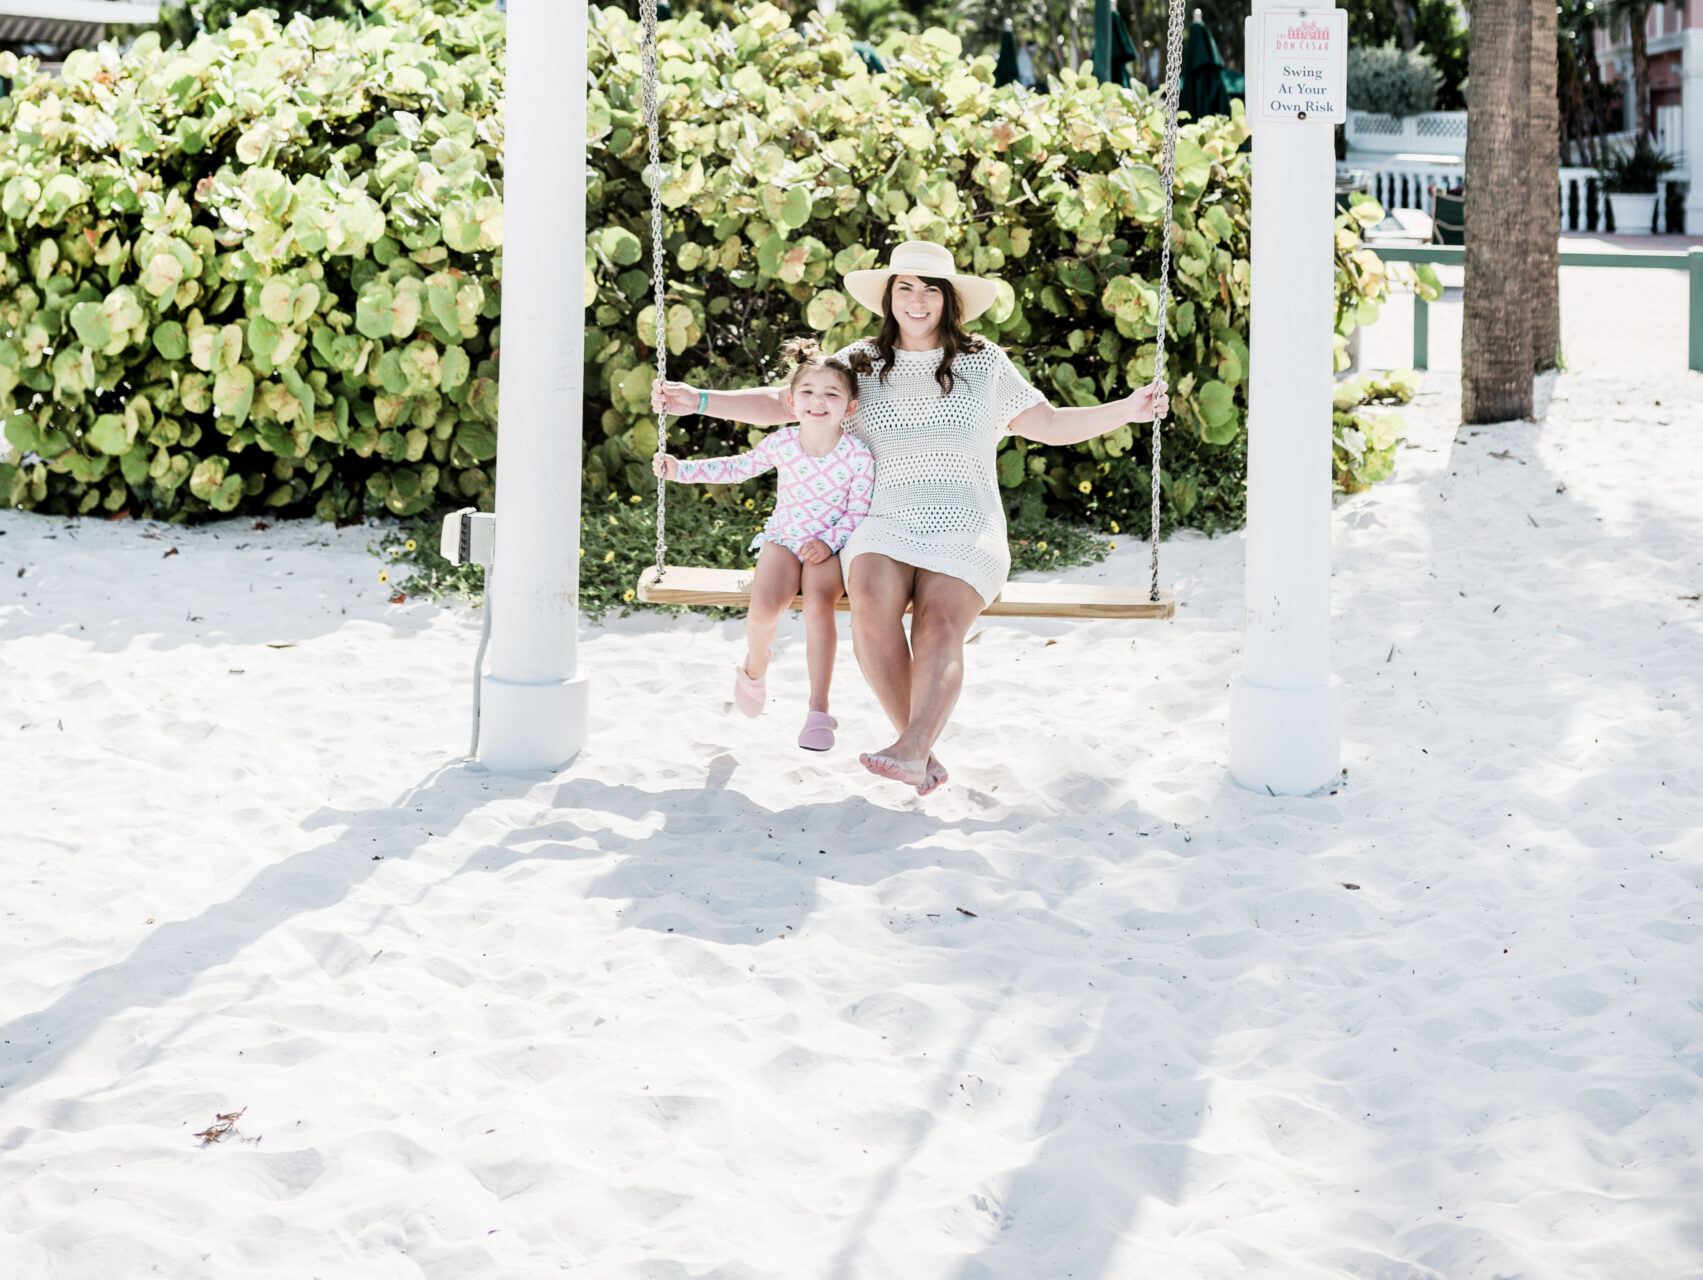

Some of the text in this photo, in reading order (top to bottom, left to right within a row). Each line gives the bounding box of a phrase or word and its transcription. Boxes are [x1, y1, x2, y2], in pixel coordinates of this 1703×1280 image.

[1276, 40, 1329, 51] DON CESAR
[1283, 65, 1322, 80] Swing
[1278, 83, 1327, 95] At Your
[1270, 100, 1334, 112] Own Risk
